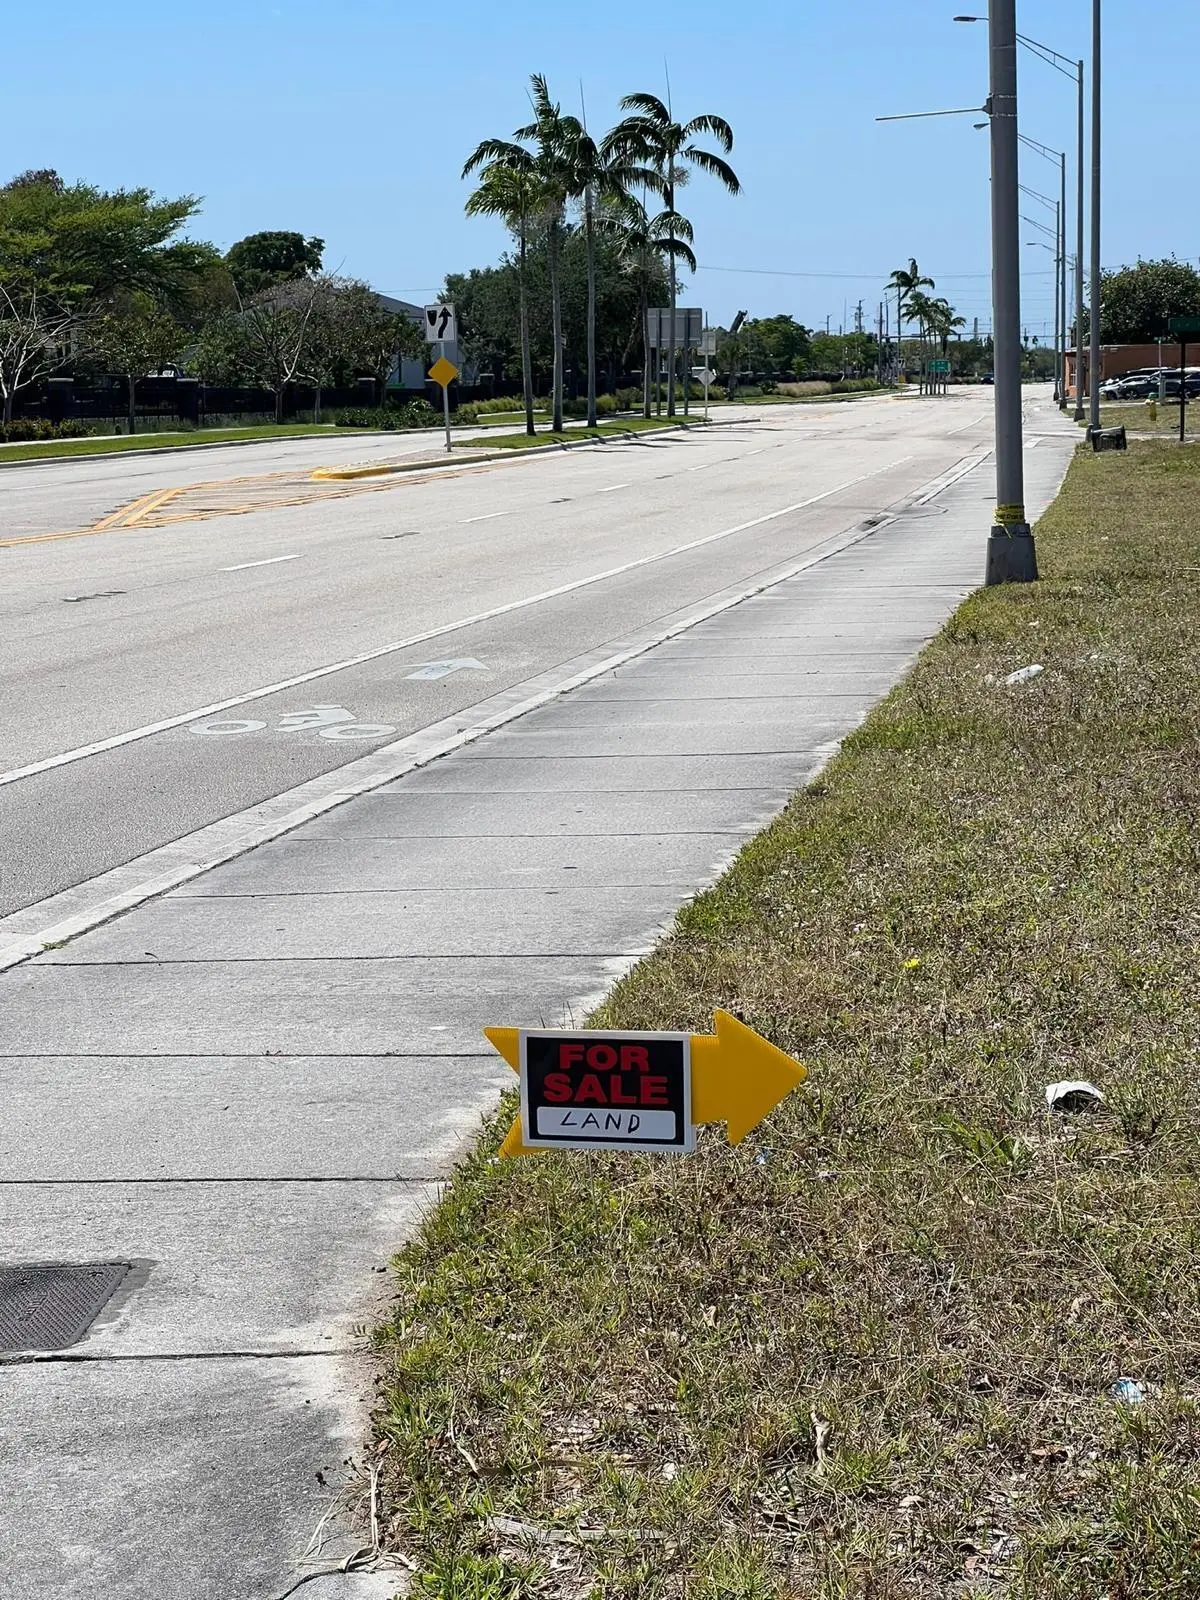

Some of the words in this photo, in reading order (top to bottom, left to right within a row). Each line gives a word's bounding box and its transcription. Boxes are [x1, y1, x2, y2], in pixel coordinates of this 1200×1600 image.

[559, 1044, 649, 1072] FOR
[543, 1073, 668, 1105] SALE
[560, 1111, 640, 1134] LAND
